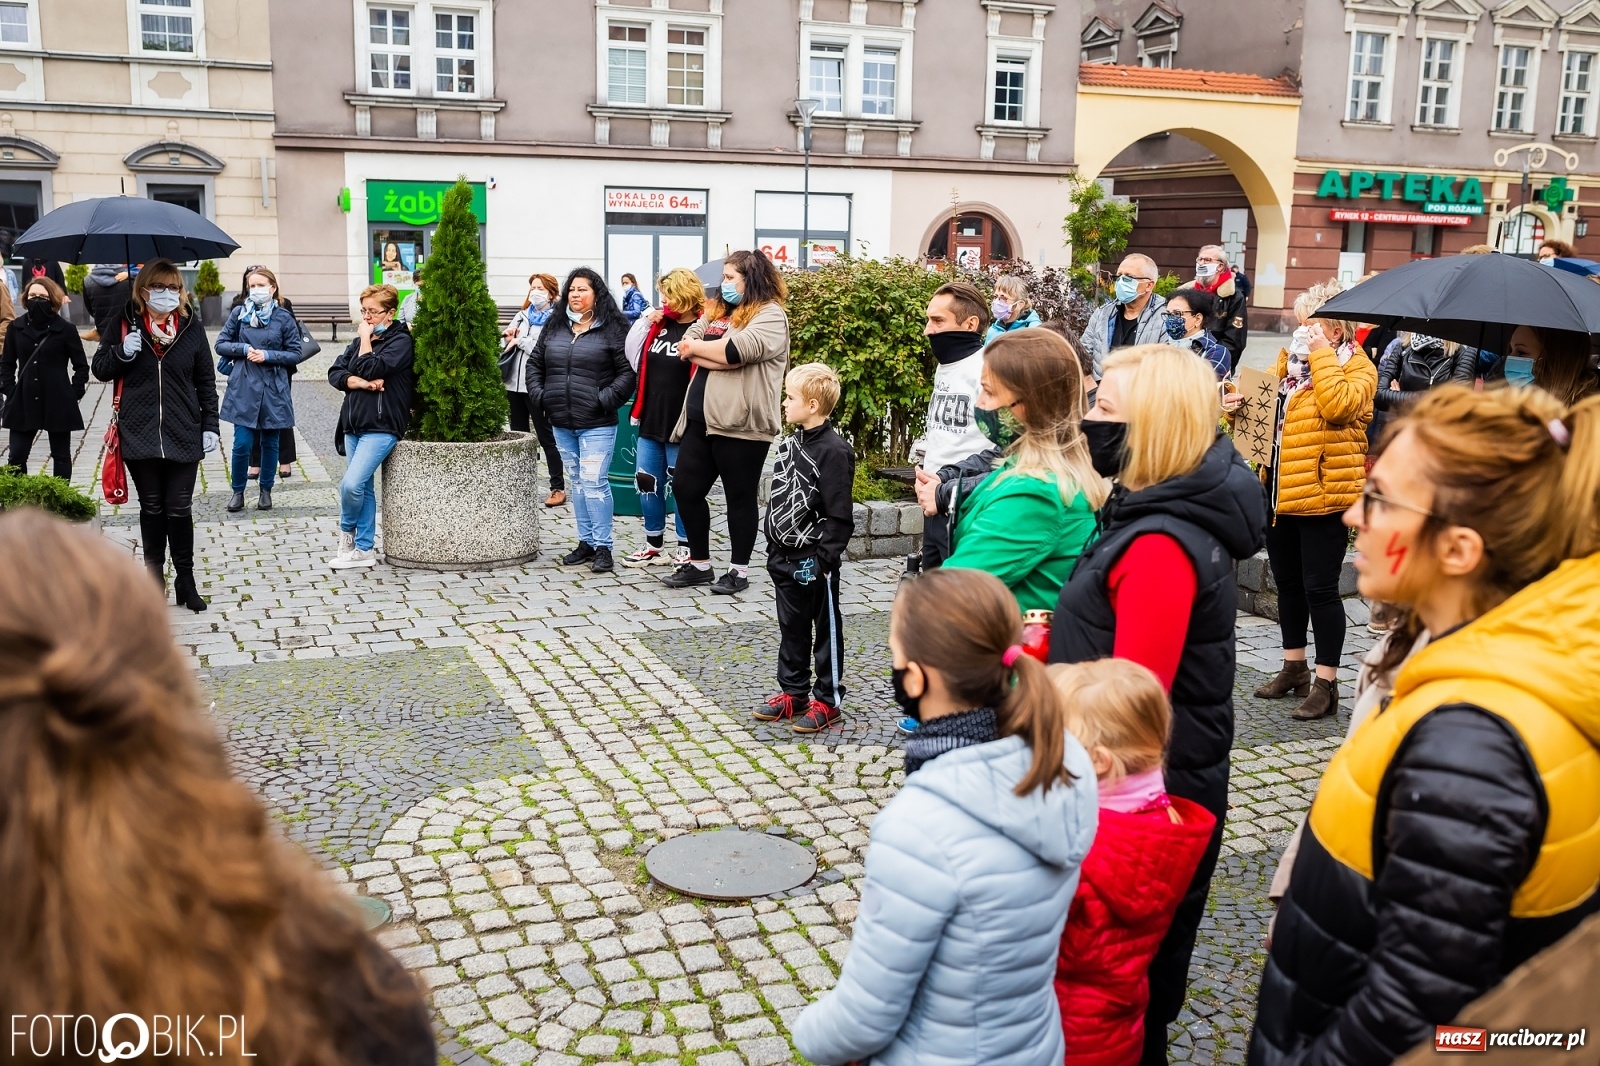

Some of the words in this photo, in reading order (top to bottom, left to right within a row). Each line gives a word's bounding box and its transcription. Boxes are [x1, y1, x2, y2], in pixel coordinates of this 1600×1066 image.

[1316, 169, 1485, 204] APTEKA
[384, 189, 445, 213] żab
[608, 192, 646, 200] LOKAL
[608, 200, 665, 209] WYNAJĘCIA
[1428, 204, 1446, 212] POD
[1449, 203, 1482, 214] RÓŻAMI
[1334, 211, 1360, 220] RYNEK
[1360, 213, 1369, 221] 12
[1373, 213, 1407, 222] CENTRUM
[1408, 214, 1468, 225] FARMACEUTYCZNE
